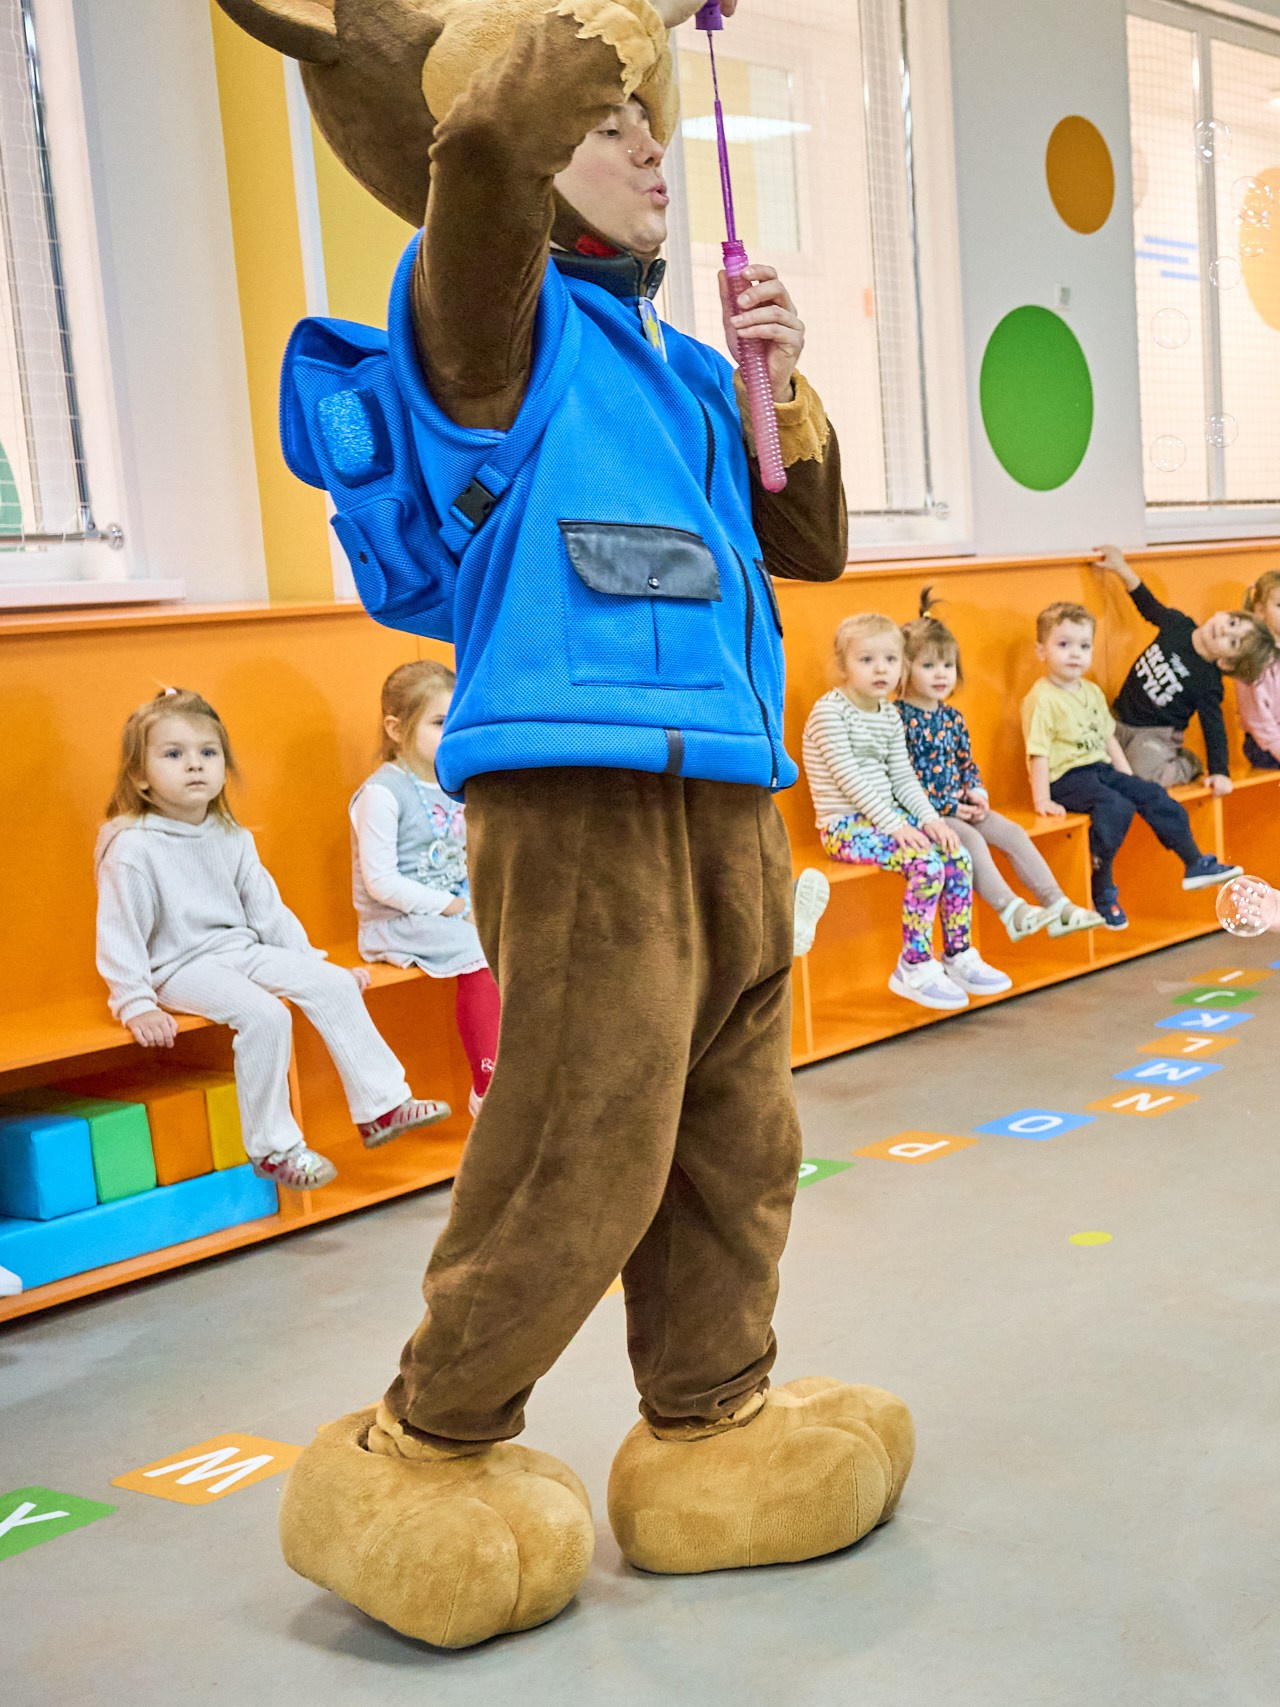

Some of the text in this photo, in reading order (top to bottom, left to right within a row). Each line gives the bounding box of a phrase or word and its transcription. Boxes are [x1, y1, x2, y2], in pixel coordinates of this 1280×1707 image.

[1145, 643, 1184, 695] SKATE
[1135, 656, 1174, 707] STYLE
[1193, 990, 1237, 1003] J
[1180, 1013, 1232, 1028] K
[1182, 1037, 1214, 1053] L
[1111, 1092, 1176, 1112] N
[1007, 1115, 1064, 1133] O
[887, 1140, 951, 1158] P
